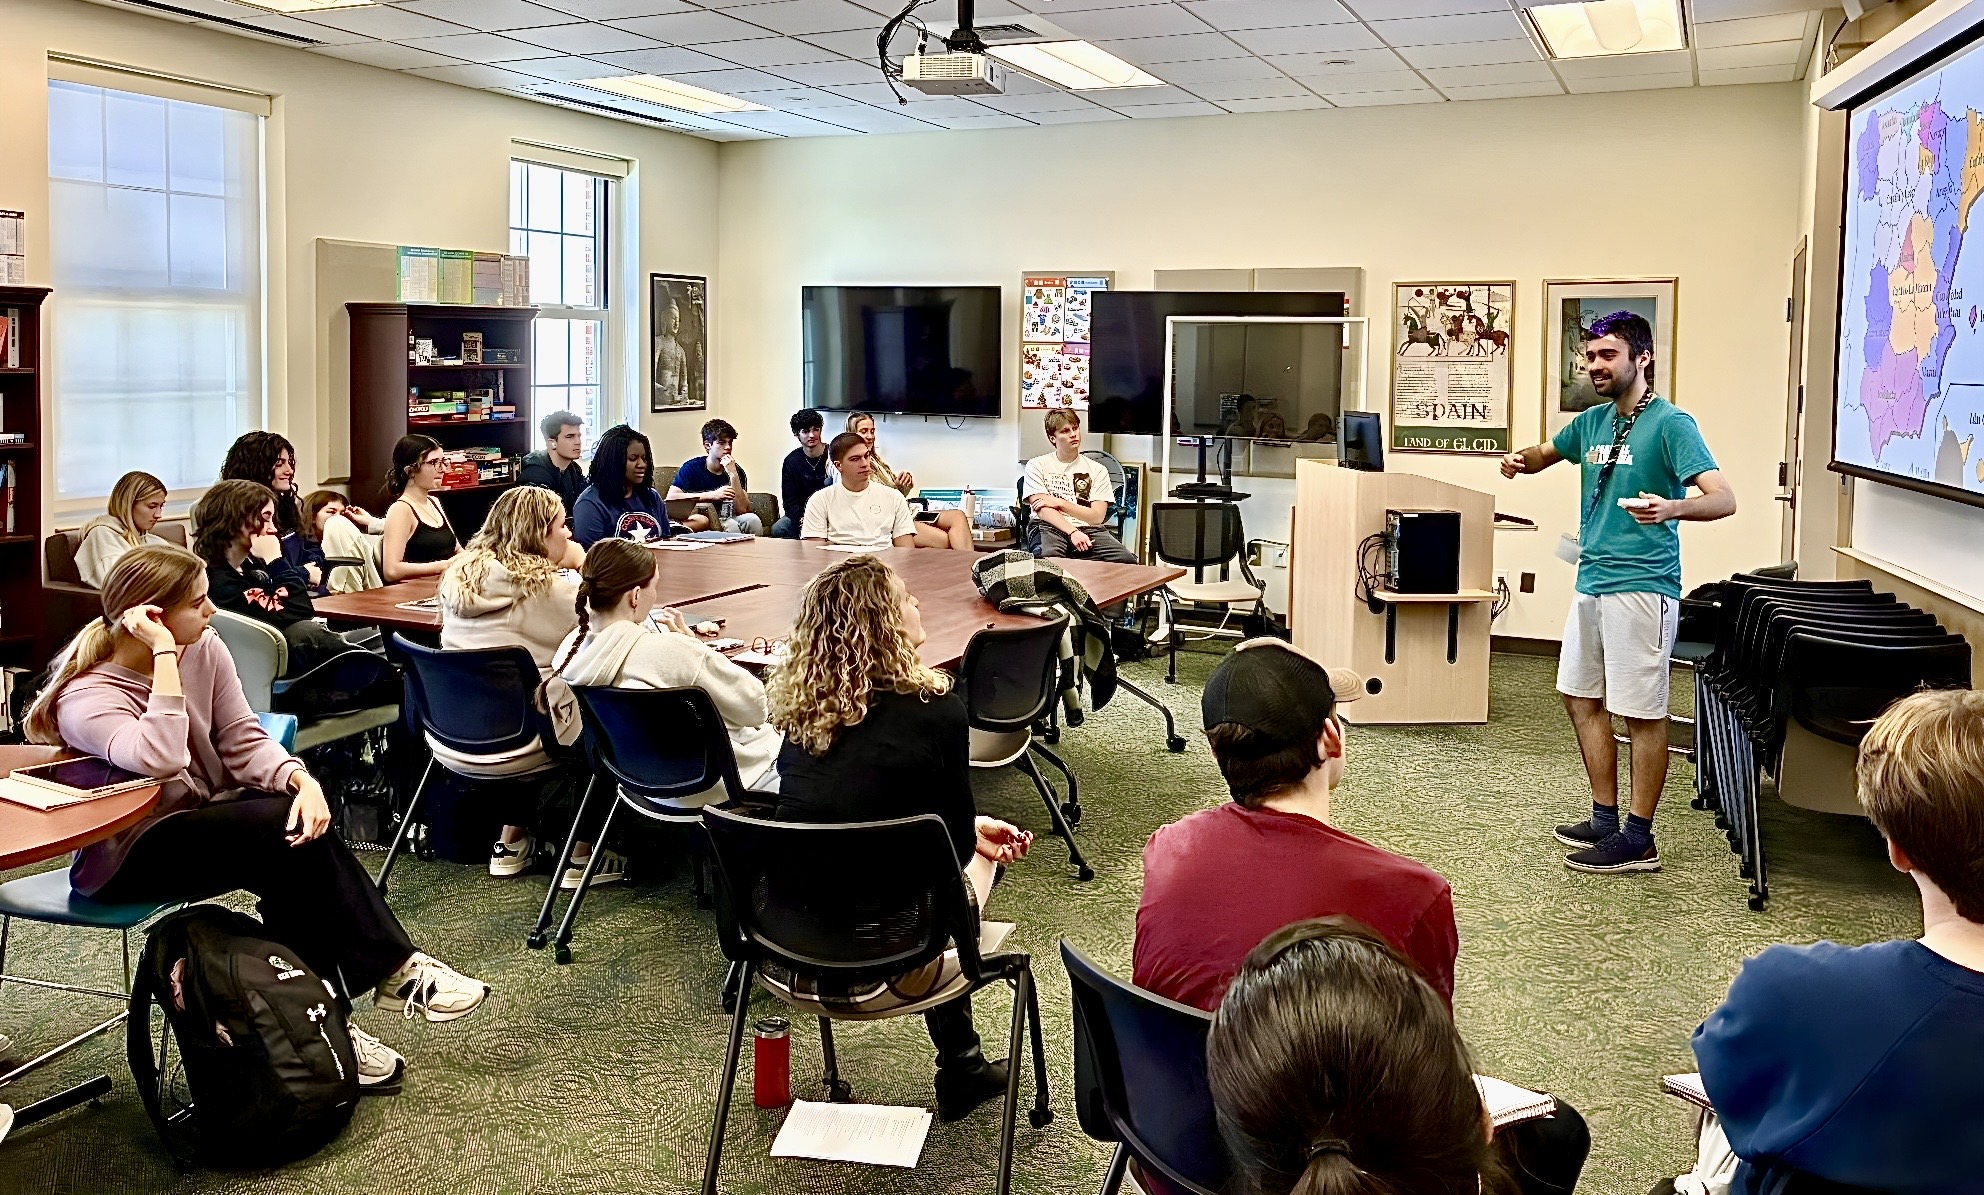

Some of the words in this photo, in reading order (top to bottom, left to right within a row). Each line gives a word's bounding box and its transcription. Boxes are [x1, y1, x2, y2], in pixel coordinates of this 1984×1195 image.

[1416, 403, 1487, 421] SPAIN
[1403, 437, 1432, 448] LAND
[1435, 438, 1450, 449] OF
[1453, 437, 1471, 451] EL
[1472, 438, 1498, 451] CID
